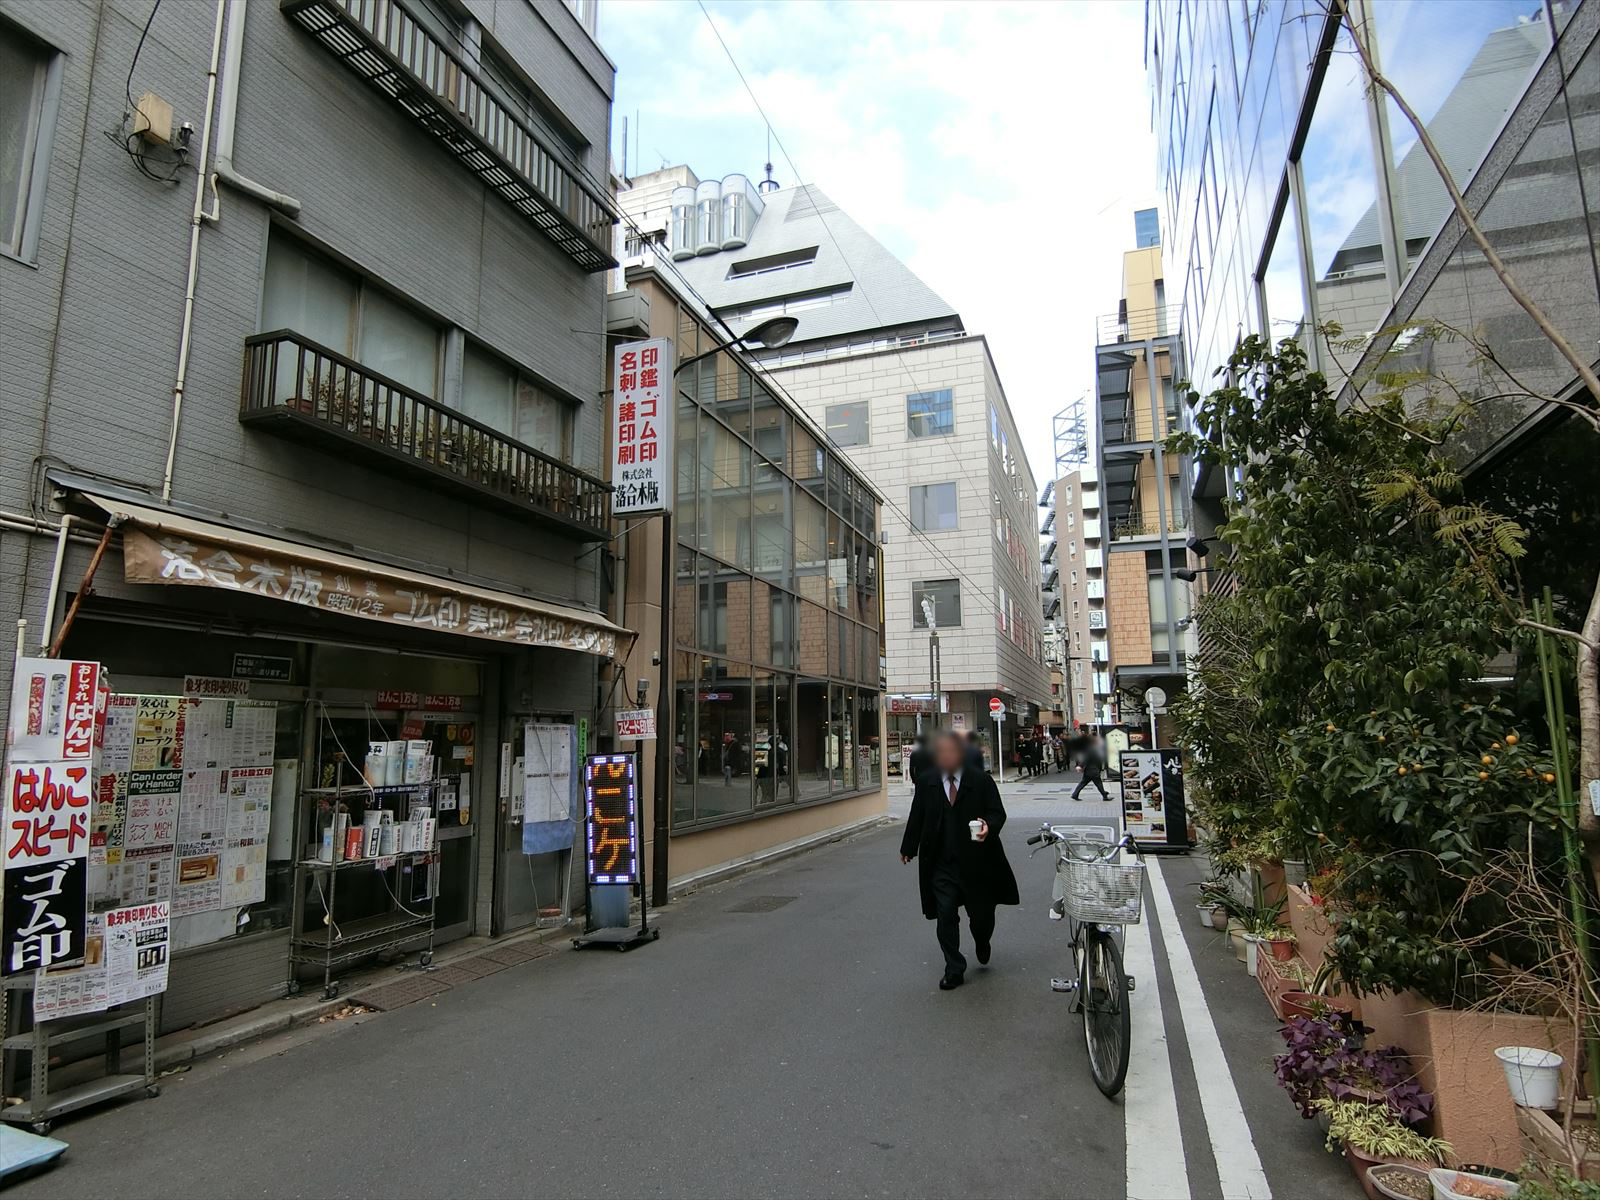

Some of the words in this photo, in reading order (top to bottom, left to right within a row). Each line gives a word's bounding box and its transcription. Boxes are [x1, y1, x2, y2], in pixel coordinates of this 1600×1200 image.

[617, 351, 637, 466] 名刺・諸印刷
[639, 347, 660, 462] 印鑑・ゴム印
[622, 467, 653, 481] 株式会社
[615, 481, 659, 508] 落合木版
[158, 537, 324, 608] 落合木版
[325, 591, 385, 618] 昭和12年
[138, 709, 177, 720] ハイテク
[139, 697, 169, 709] 安心は
[136, 735, 173, 746] ローテク
[12, 767, 90, 813] はんこ
[130, 782, 145, 790] my
[131, 772, 151, 782] Can
[156, 771, 182, 780] order
[7, 811, 88, 860] スピード
[10, 859, 77, 972] ゴム印
